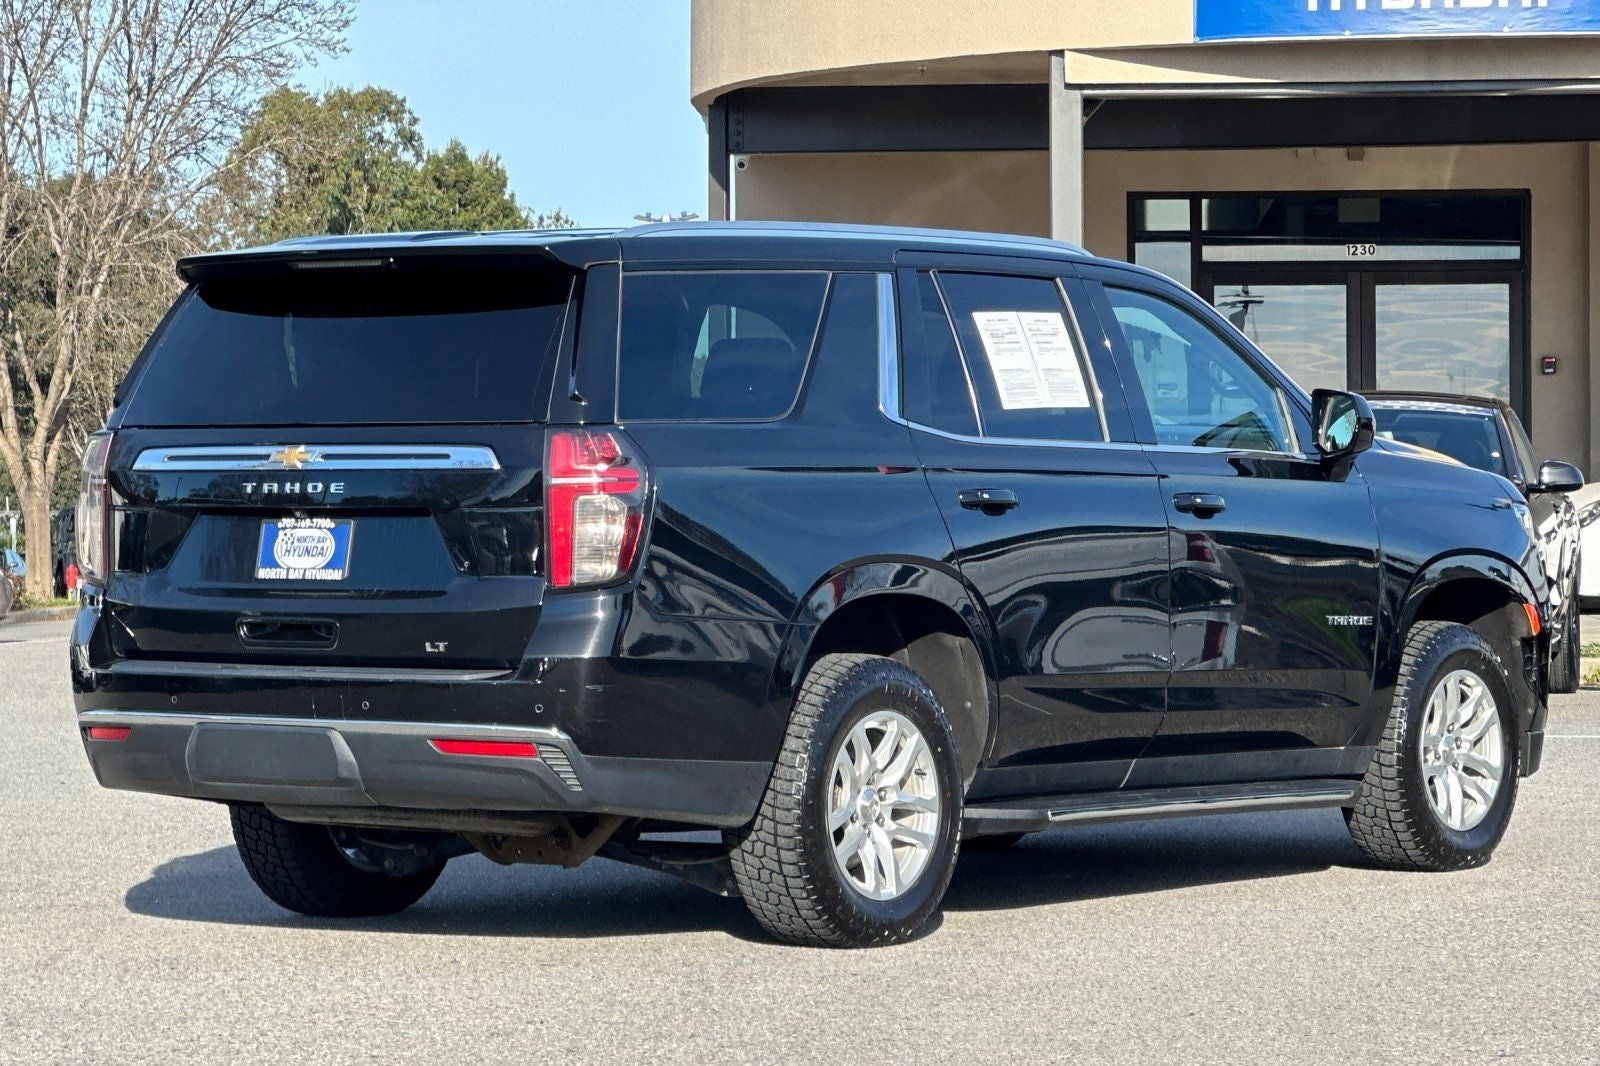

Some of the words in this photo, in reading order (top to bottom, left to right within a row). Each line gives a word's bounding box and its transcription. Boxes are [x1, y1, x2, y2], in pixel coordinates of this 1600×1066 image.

[1346, 244, 1376, 256] 1230
[242, 482, 345, 494] TAHOE
[296, 535, 316, 544] NORTH
[316, 536, 329, 545] BAY
[283, 545, 329, 558] HYUNDAI
[258, 567, 287, 580] NORTH
[288, 568, 304, 580] BAY
[305, 569, 343, 580] HYUNDAI
[1325, 615, 1373, 626] TAHOE
[425, 642, 449, 652] LT
